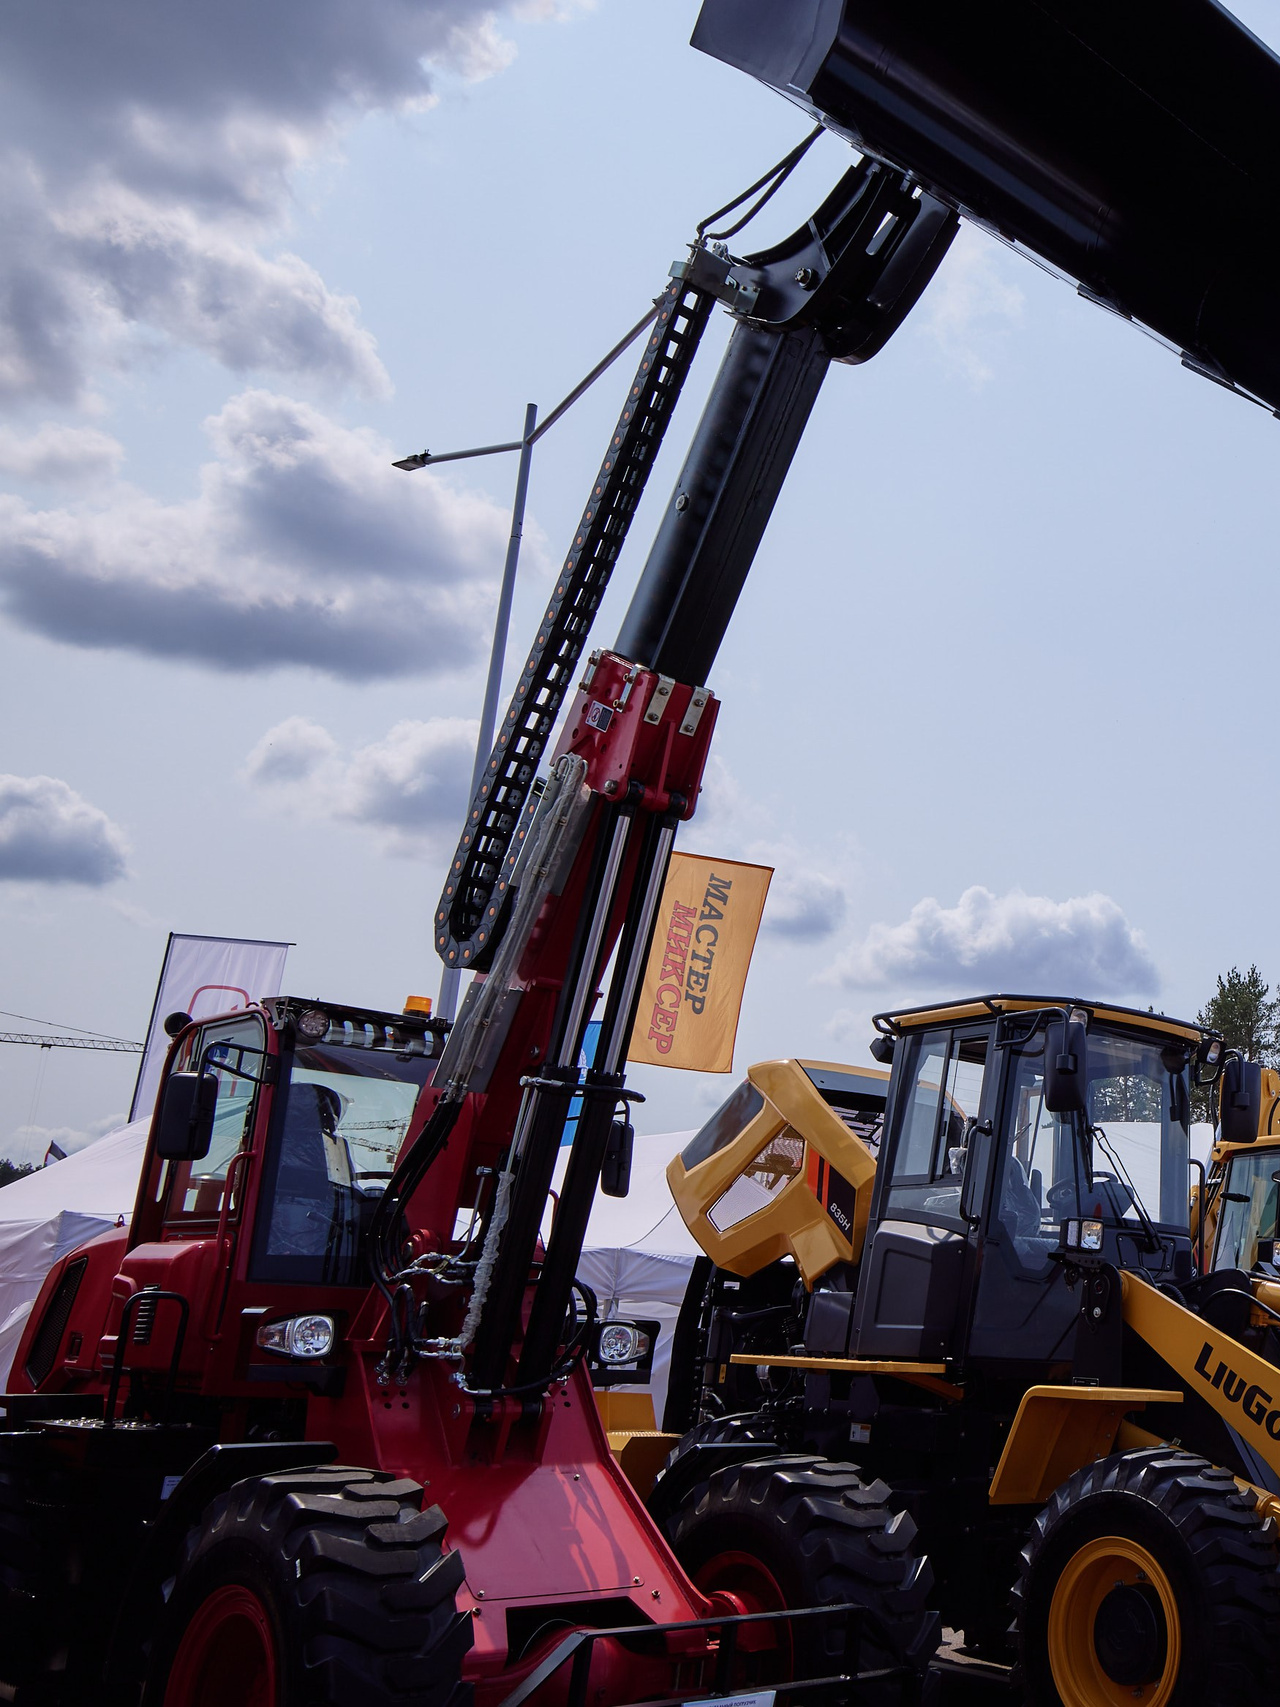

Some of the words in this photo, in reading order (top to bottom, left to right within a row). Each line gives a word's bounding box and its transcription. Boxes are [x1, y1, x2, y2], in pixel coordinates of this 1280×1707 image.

[648, 900, 697, 1055] МИКСЕР
[684, 873, 732, 1015] МАСТЕР
[830, 1202, 851, 1231] 835H
